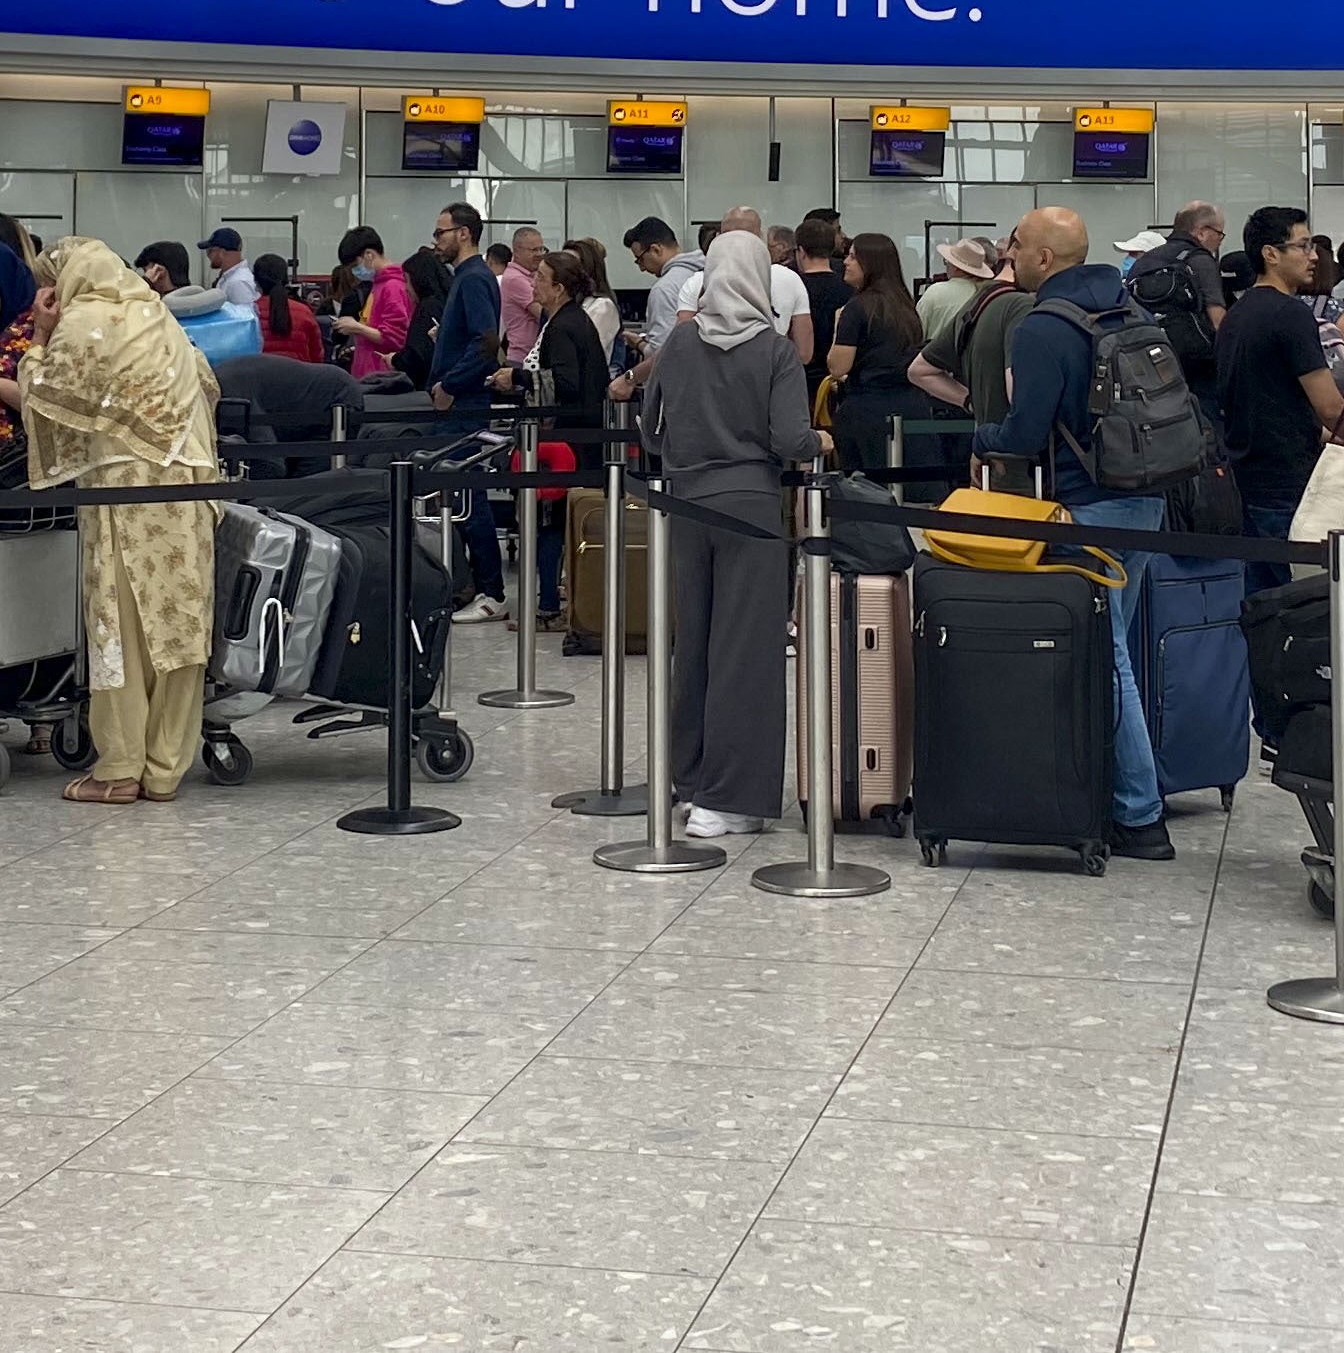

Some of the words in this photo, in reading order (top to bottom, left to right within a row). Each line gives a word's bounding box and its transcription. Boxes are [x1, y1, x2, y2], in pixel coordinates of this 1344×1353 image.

[147, 95, 162, 105] A9
[424, 104, 445, 114] A10
[630, 110, 648, 119] A11
[891, 114, 911, 123] A12
[1095, 116, 1114, 125] A13
